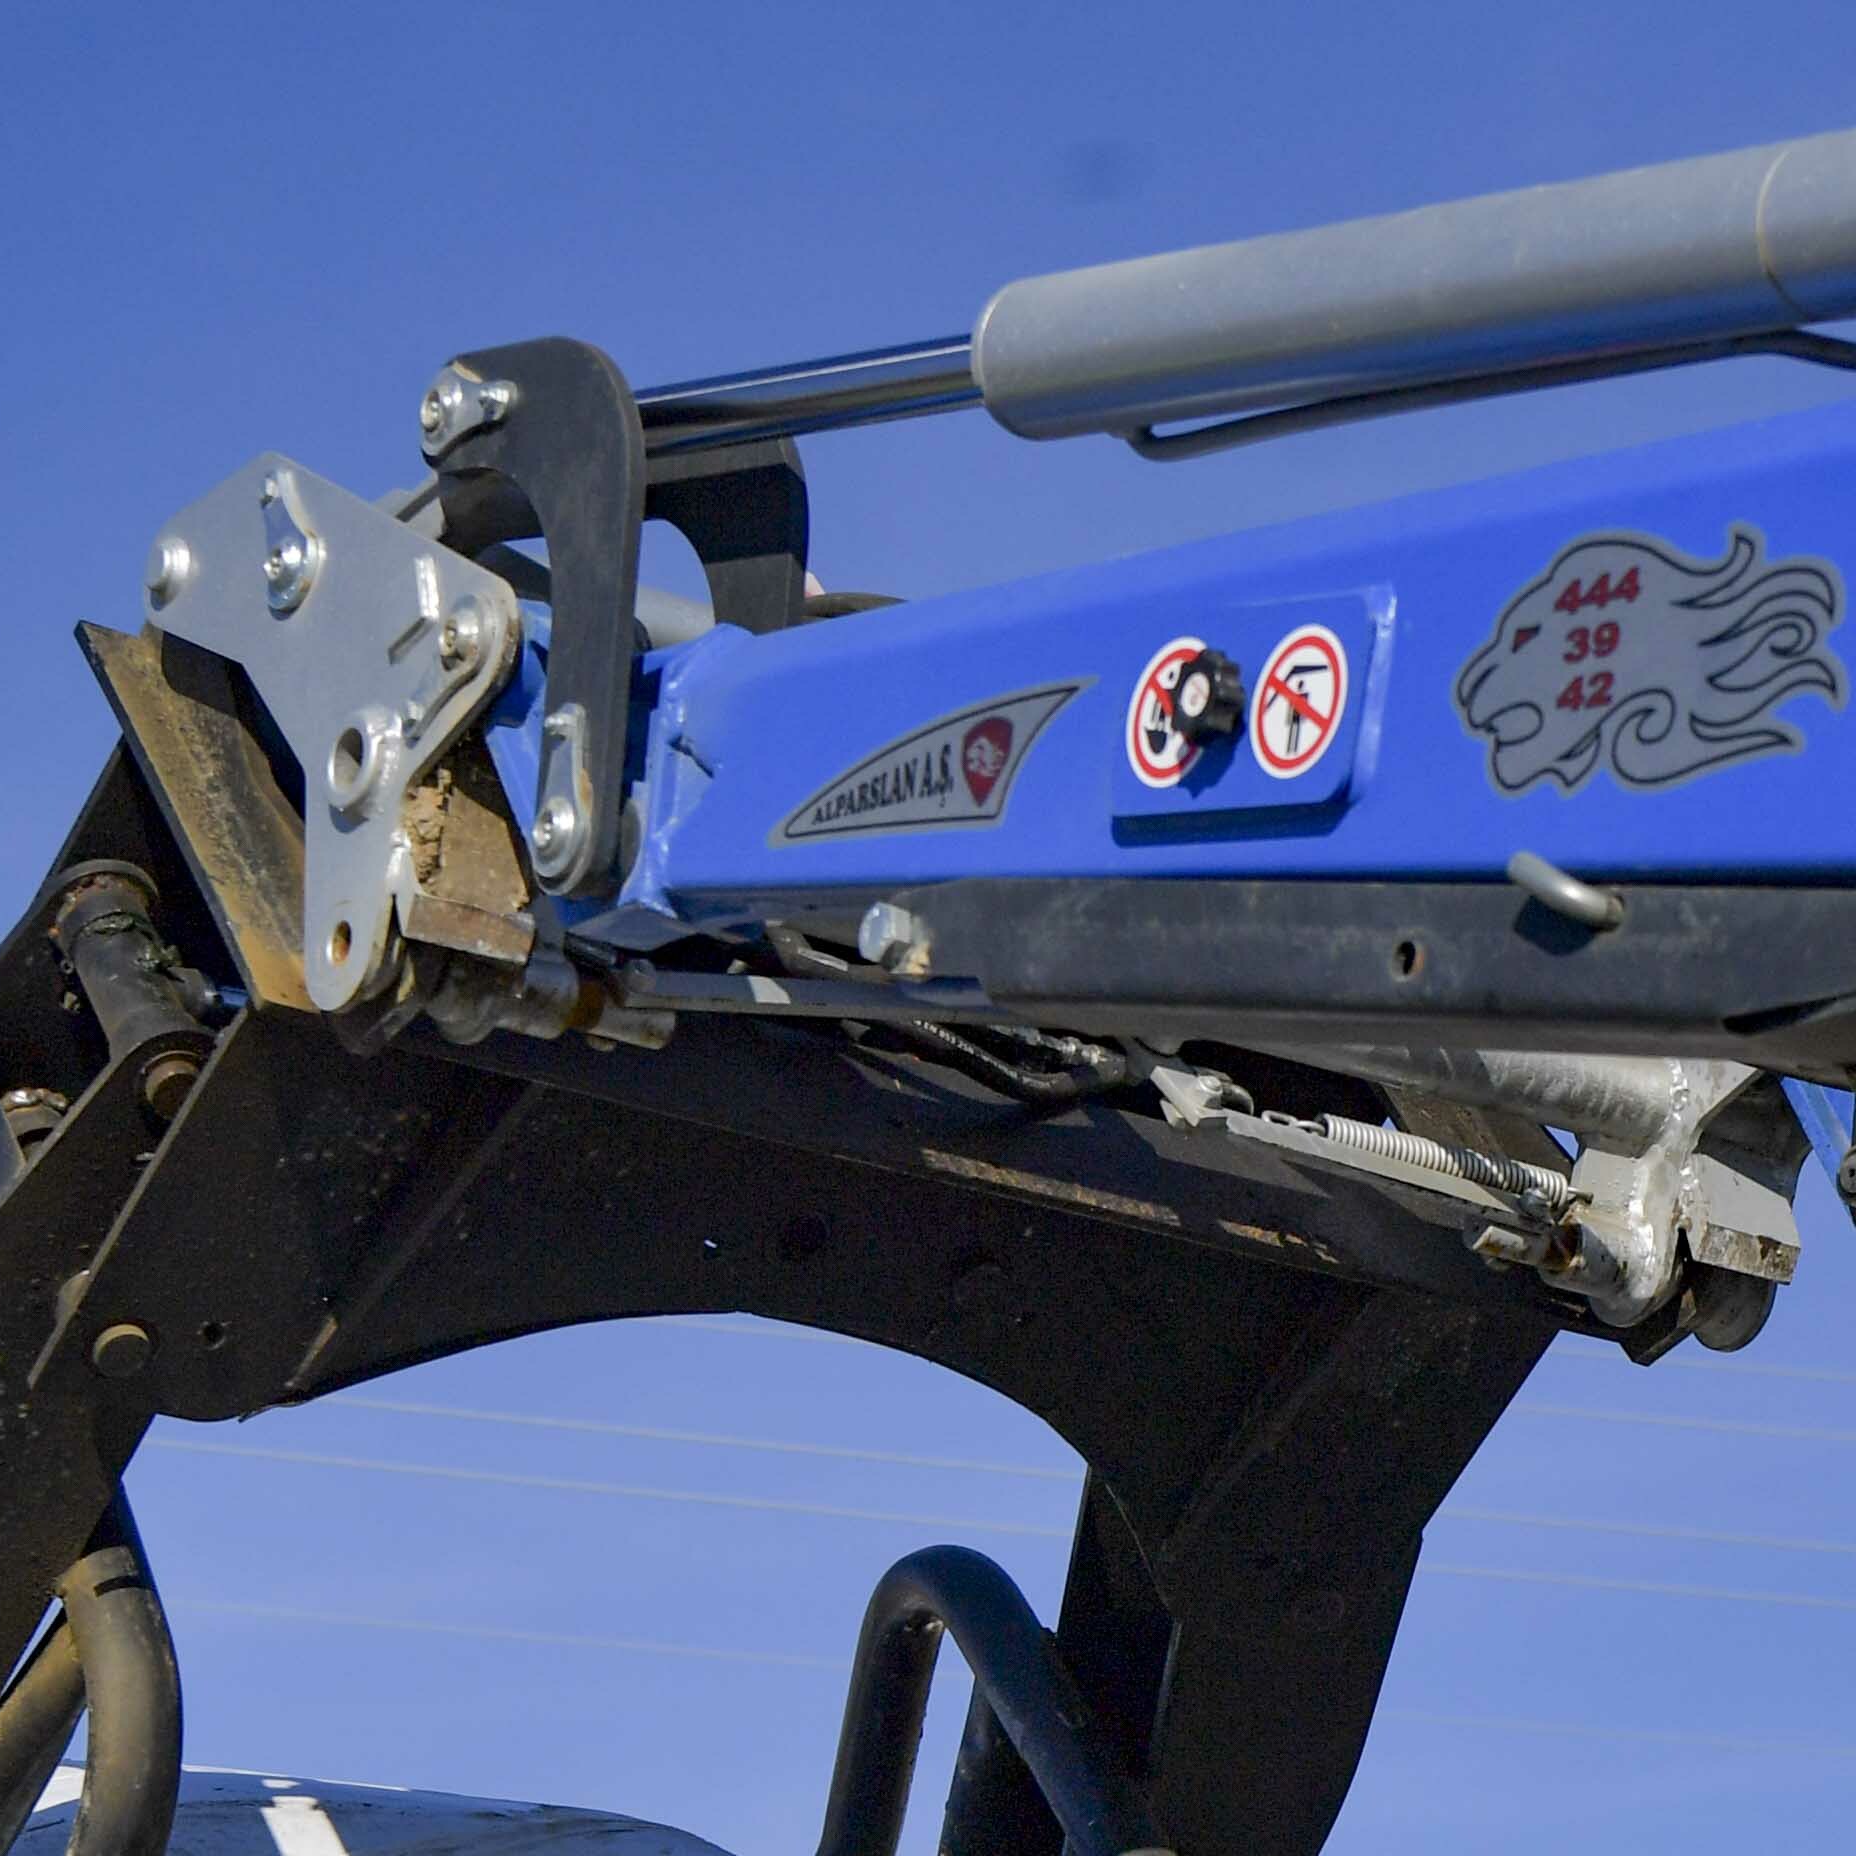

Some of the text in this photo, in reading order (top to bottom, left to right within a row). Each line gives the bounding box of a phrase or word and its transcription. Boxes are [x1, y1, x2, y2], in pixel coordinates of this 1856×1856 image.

[1553, 565, 1640, 615] 444
[1563, 621, 1620, 664] 39
[1556, 671, 1614, 711] 42
[812, 757, 918, 825] ALPARSLAN
